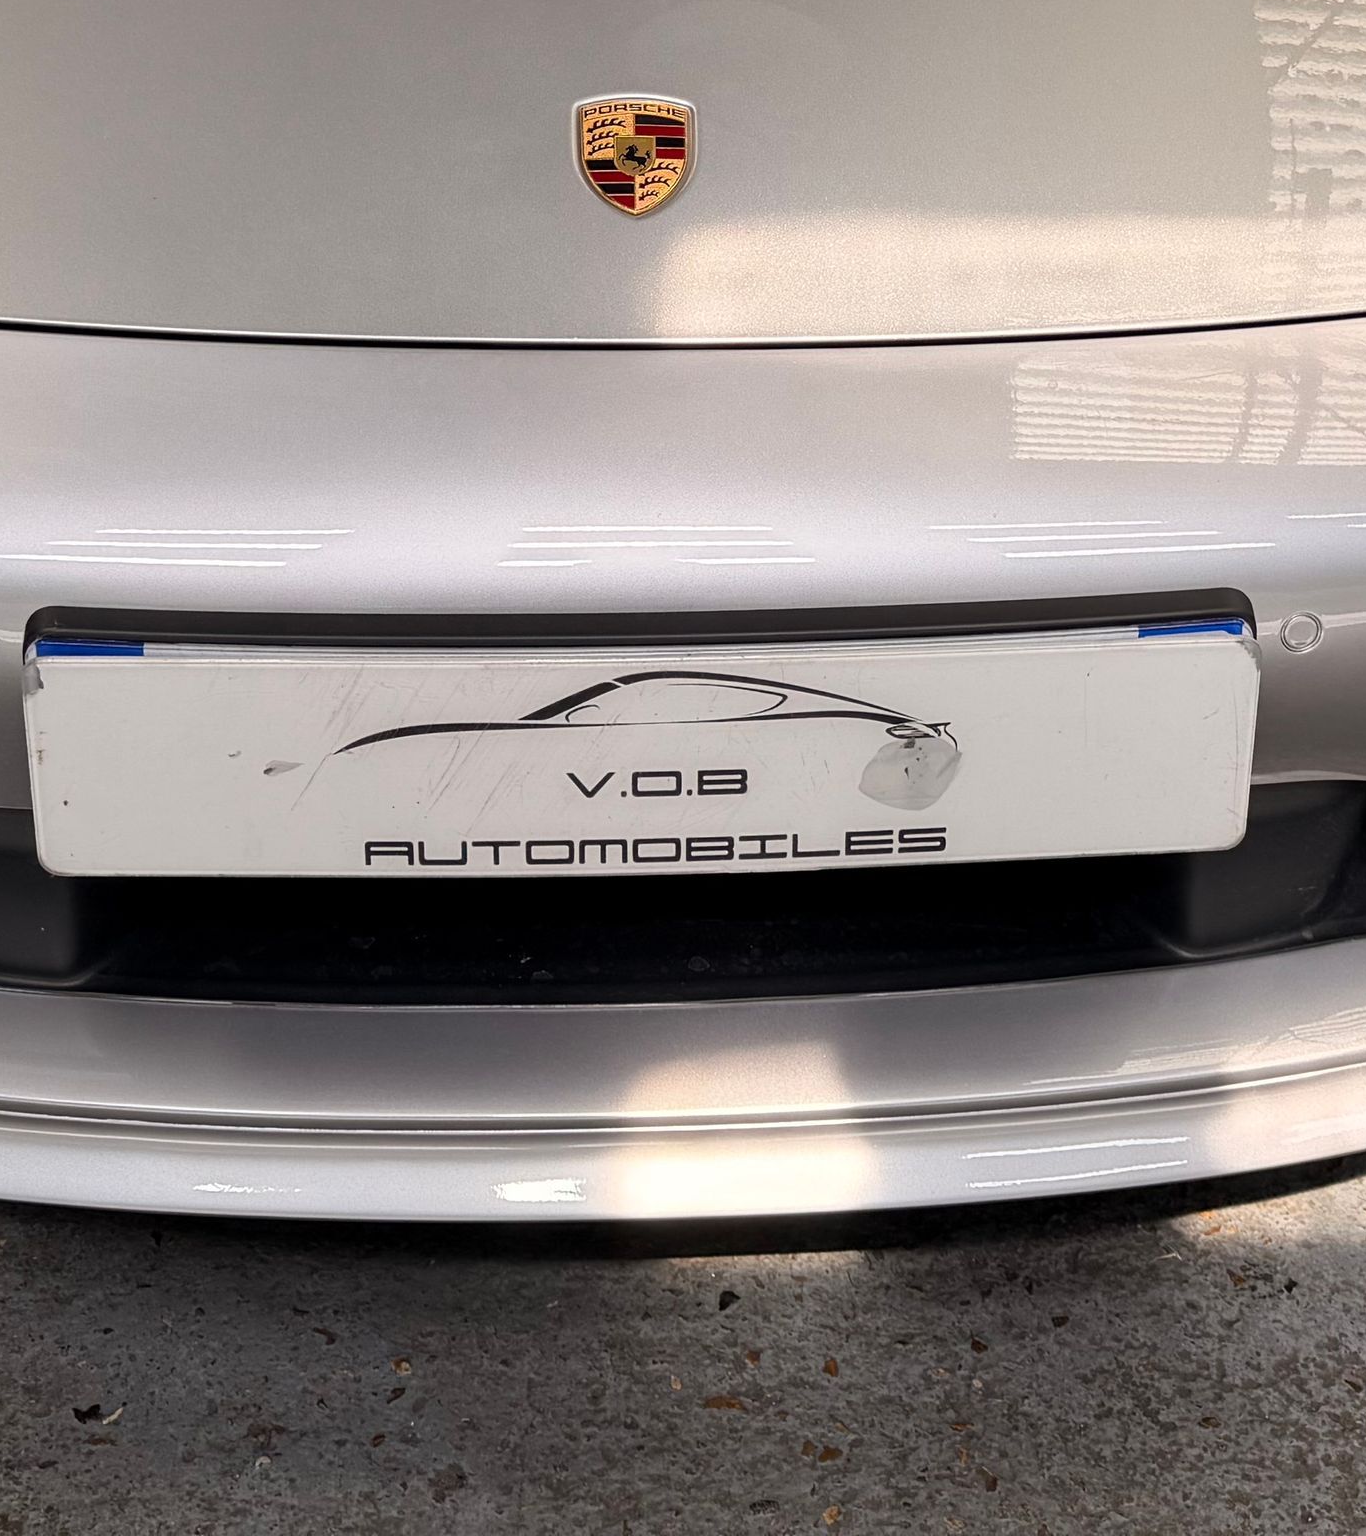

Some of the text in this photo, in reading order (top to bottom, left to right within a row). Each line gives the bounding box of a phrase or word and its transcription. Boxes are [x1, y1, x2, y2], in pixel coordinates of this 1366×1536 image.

[584, 103, 686, 119] PORSCHE
[566, 768, 748, 799] V.O.B
[364, 826, 947, 866] AUTOMOBILES
